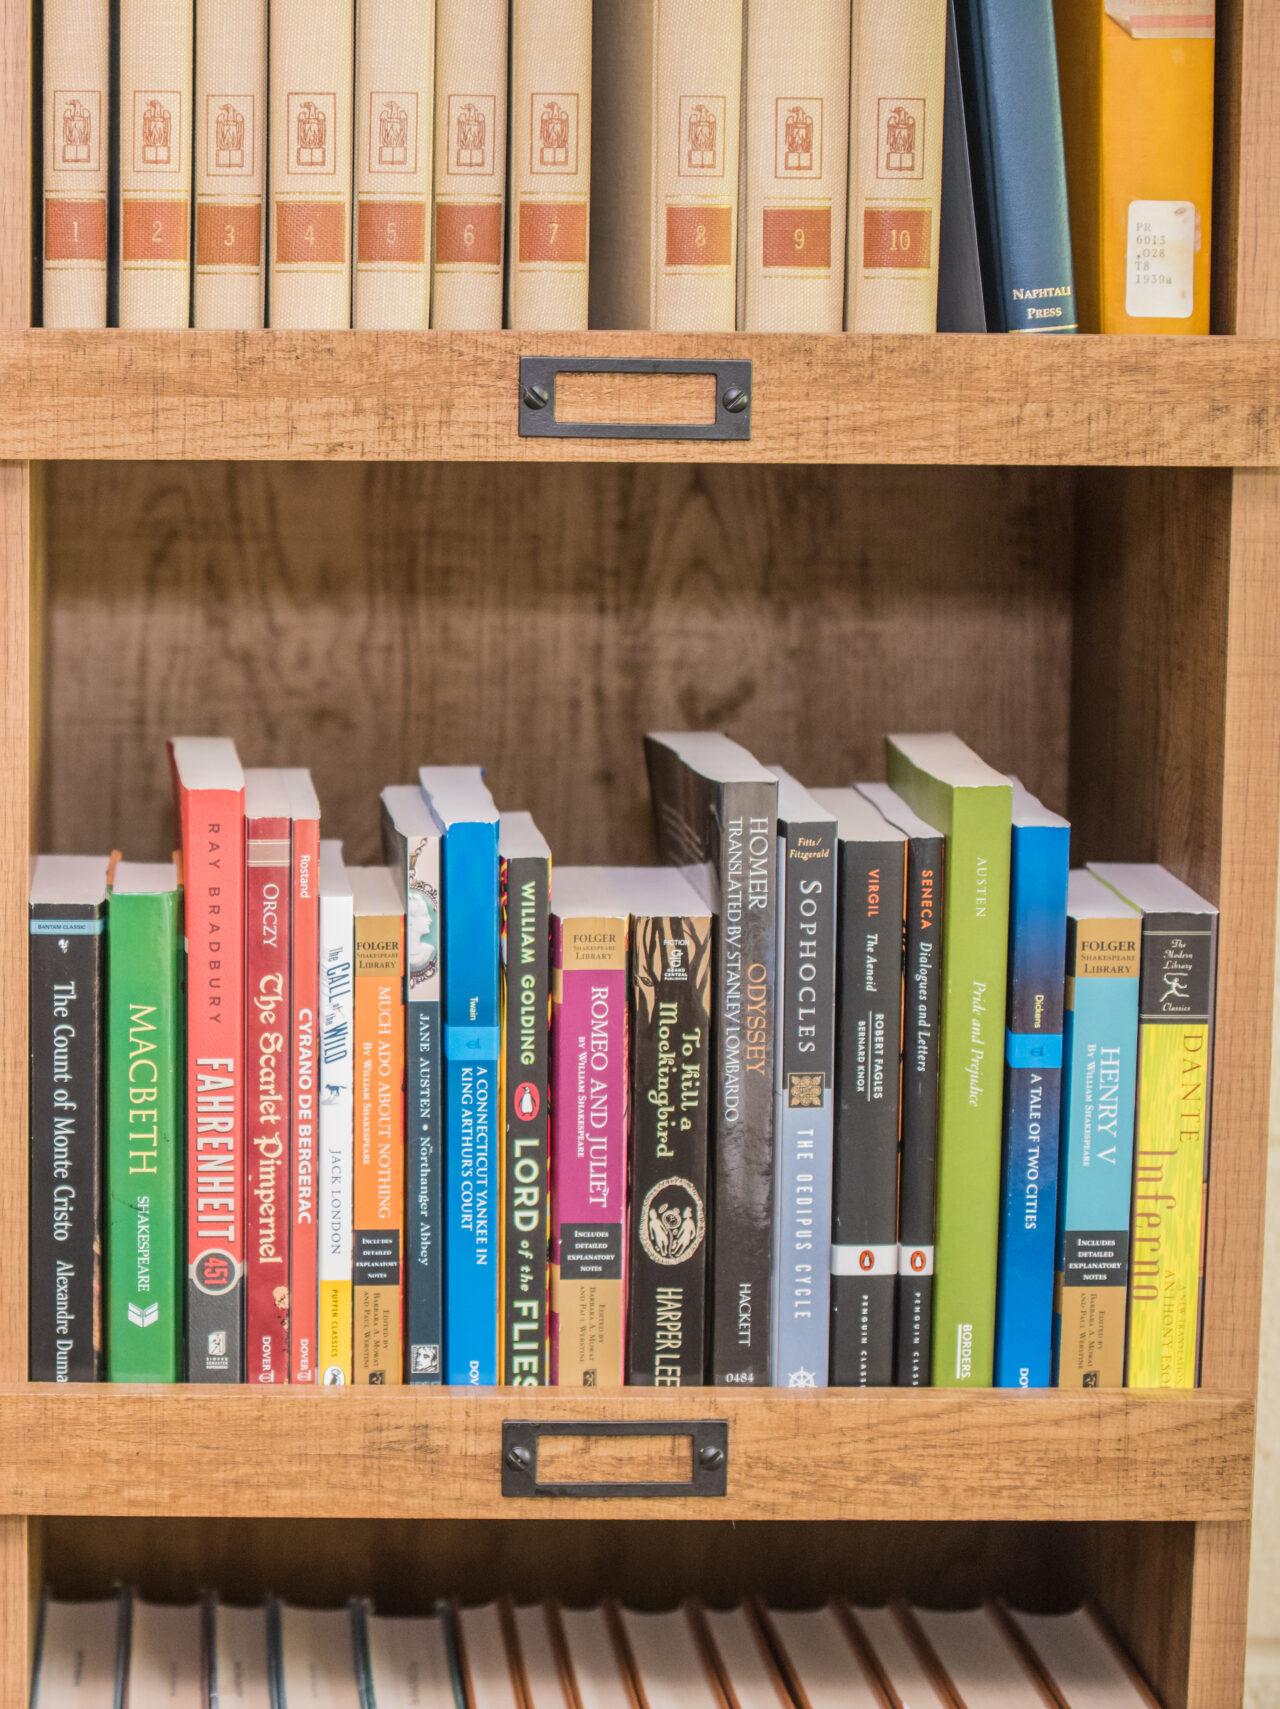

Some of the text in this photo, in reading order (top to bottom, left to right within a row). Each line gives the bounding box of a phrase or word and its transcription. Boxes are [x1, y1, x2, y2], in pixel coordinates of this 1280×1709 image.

[151, 220, 163, 243] 2
[223, 224, 235, 246] 3
[303, 223, 315, 245] 4
[386, 221, 398, 244] 5
[463, 223, 475, 246] 6
[547, 222, 558, 245] 7
[793, 229, 805, 250] 9
[889, 230, 911, 251] 10
[1135, 223, 1151, 231] PR
[1136, 235, 1166, 245] 6013
[1027, 307, 1062, 319] PRESS
[299, 854, 311, 899] Rostand
[748, 816, 769, 911] HOMER
[867, 868, 881, 917] VIRGIL
[975, 856, 988, 918] AUSTEN
[208, 823, 221, 1025] RAY BRADBURY
[261, 883, 280, 948] ORCZY
[920, 869, 934, 930] SENECA
[520, 880, 536, 1066] WILLIAM GOLDING
[798, 879, 822, 1053] SOPHOCLES
[864, 954, 877, 992] Aeneid
[1083, 962, 1132, 975] LIBRARY
[322, 961, 352, 1065] CALL WILD
[469, 996, 480, 1021] Twain
[746, 962, 767, 1077] ODYSSEY
[915, 941, 933, 1072] Dialogues Letters
[1033, 994, 1045, 1029] Dickens
[128, 1002, 158, 1175] MACBETH
[377, 986, 392, 1219] MUCH NOTHING
[585, 985, 610, 1209] ROMEO JULIET
[647, 1001, 678, 1159] Mockingbird
[872, 1058, 884, 1099] FAGLES
[964, 1047, 984, 1107] Prejudice
[1096, 1046, 1120, 1138] HENRY
[1178, 1033, 1203, 1145] DANTE
[52, 1023, 76, 1242] Count Monte Cristo
[253, 1031, 284, 1265] Scarlet Pimpernel
[297, 1008, 313, 1224] CYRANO BERGERAC
[417, 1013, 433, 1267] JANE AUSTEN Northanger Abbey
[196, 1058, 235, 1243] FAHRENHEIT
[474, 1078, 489, 1245] CONNECTICUT YANKEE
[329, 1149, 342, 1255] JACK LONDON
[460, 1181, 473, 1232] COURT
[512, 1137, 540, 1233] LORD
[1024, 1183, 1040, 1230] CITIES
[136, 1195, 150, 1293] SHAKESPEARE
[793, 1173, 814, 1319] OEDIPUS CYCLE
[1077, 1251, 1114, 1259] DETAILED
[1131, 1149, 1178, 1301] Inferno
[55, 1260, 75, 1335] Alexandre
[202, 1256, 230, 1285] 451
[654, 1287, 684, 1351] HARPER
[738, 1282, 752, 1348] HACKETT
[960, 1323, 973, 1378] BORDERS
